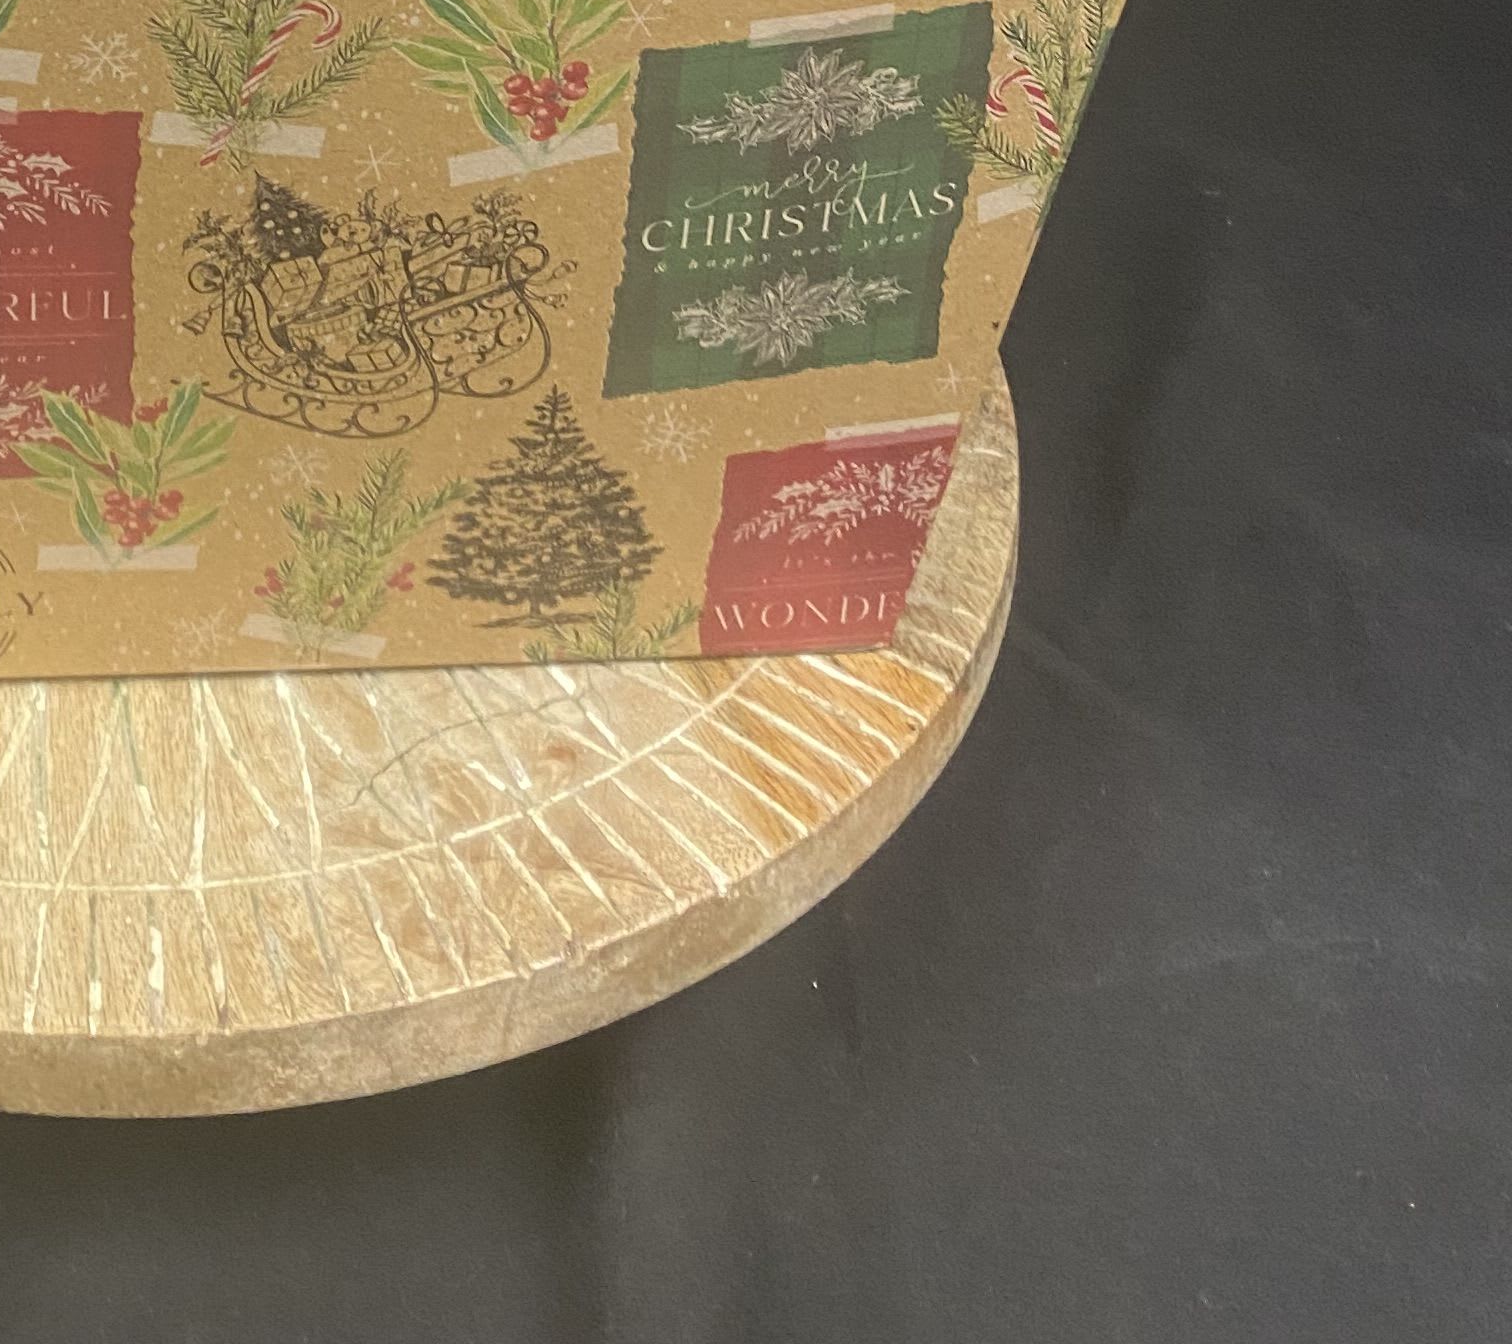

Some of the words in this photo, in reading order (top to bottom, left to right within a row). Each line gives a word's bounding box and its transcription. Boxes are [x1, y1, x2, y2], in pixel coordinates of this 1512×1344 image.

[641, 181, 957, 252] CHRISTMAS
[685, 155, 914, 217] merry
[714, 591, 902, 632] WONDE
